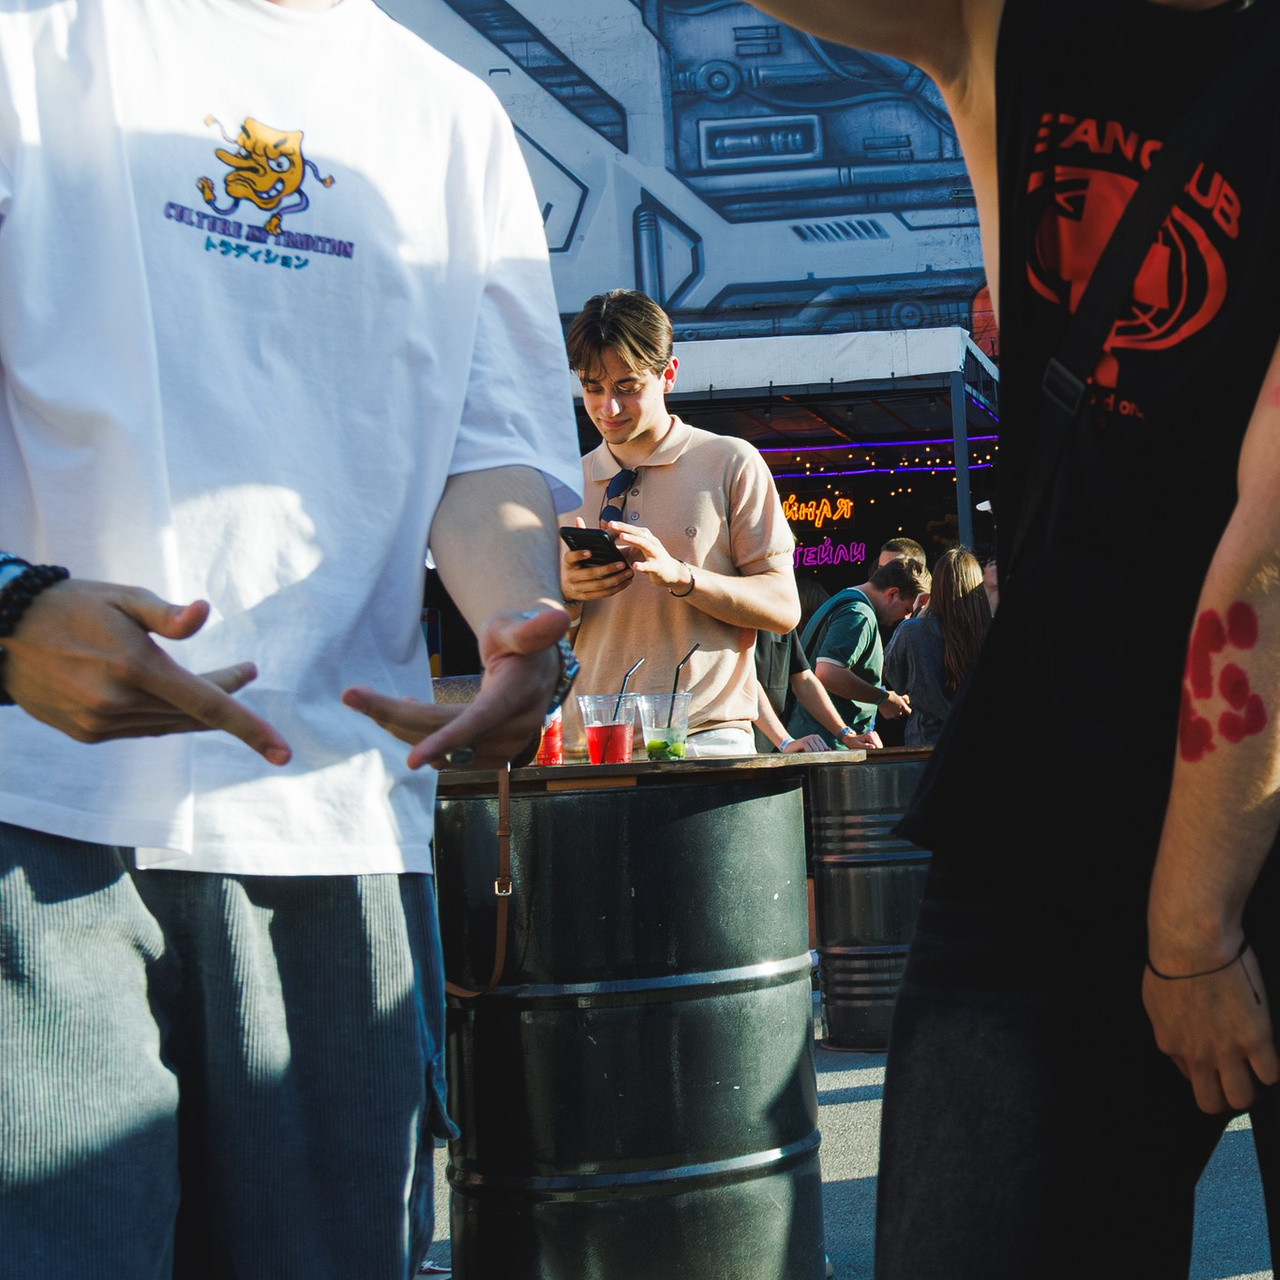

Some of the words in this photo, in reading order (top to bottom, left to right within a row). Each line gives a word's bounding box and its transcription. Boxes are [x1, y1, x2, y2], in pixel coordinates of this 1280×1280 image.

[164, 201, 243, 239] CULTURE
[204, 236, 309, 270] トラディション
